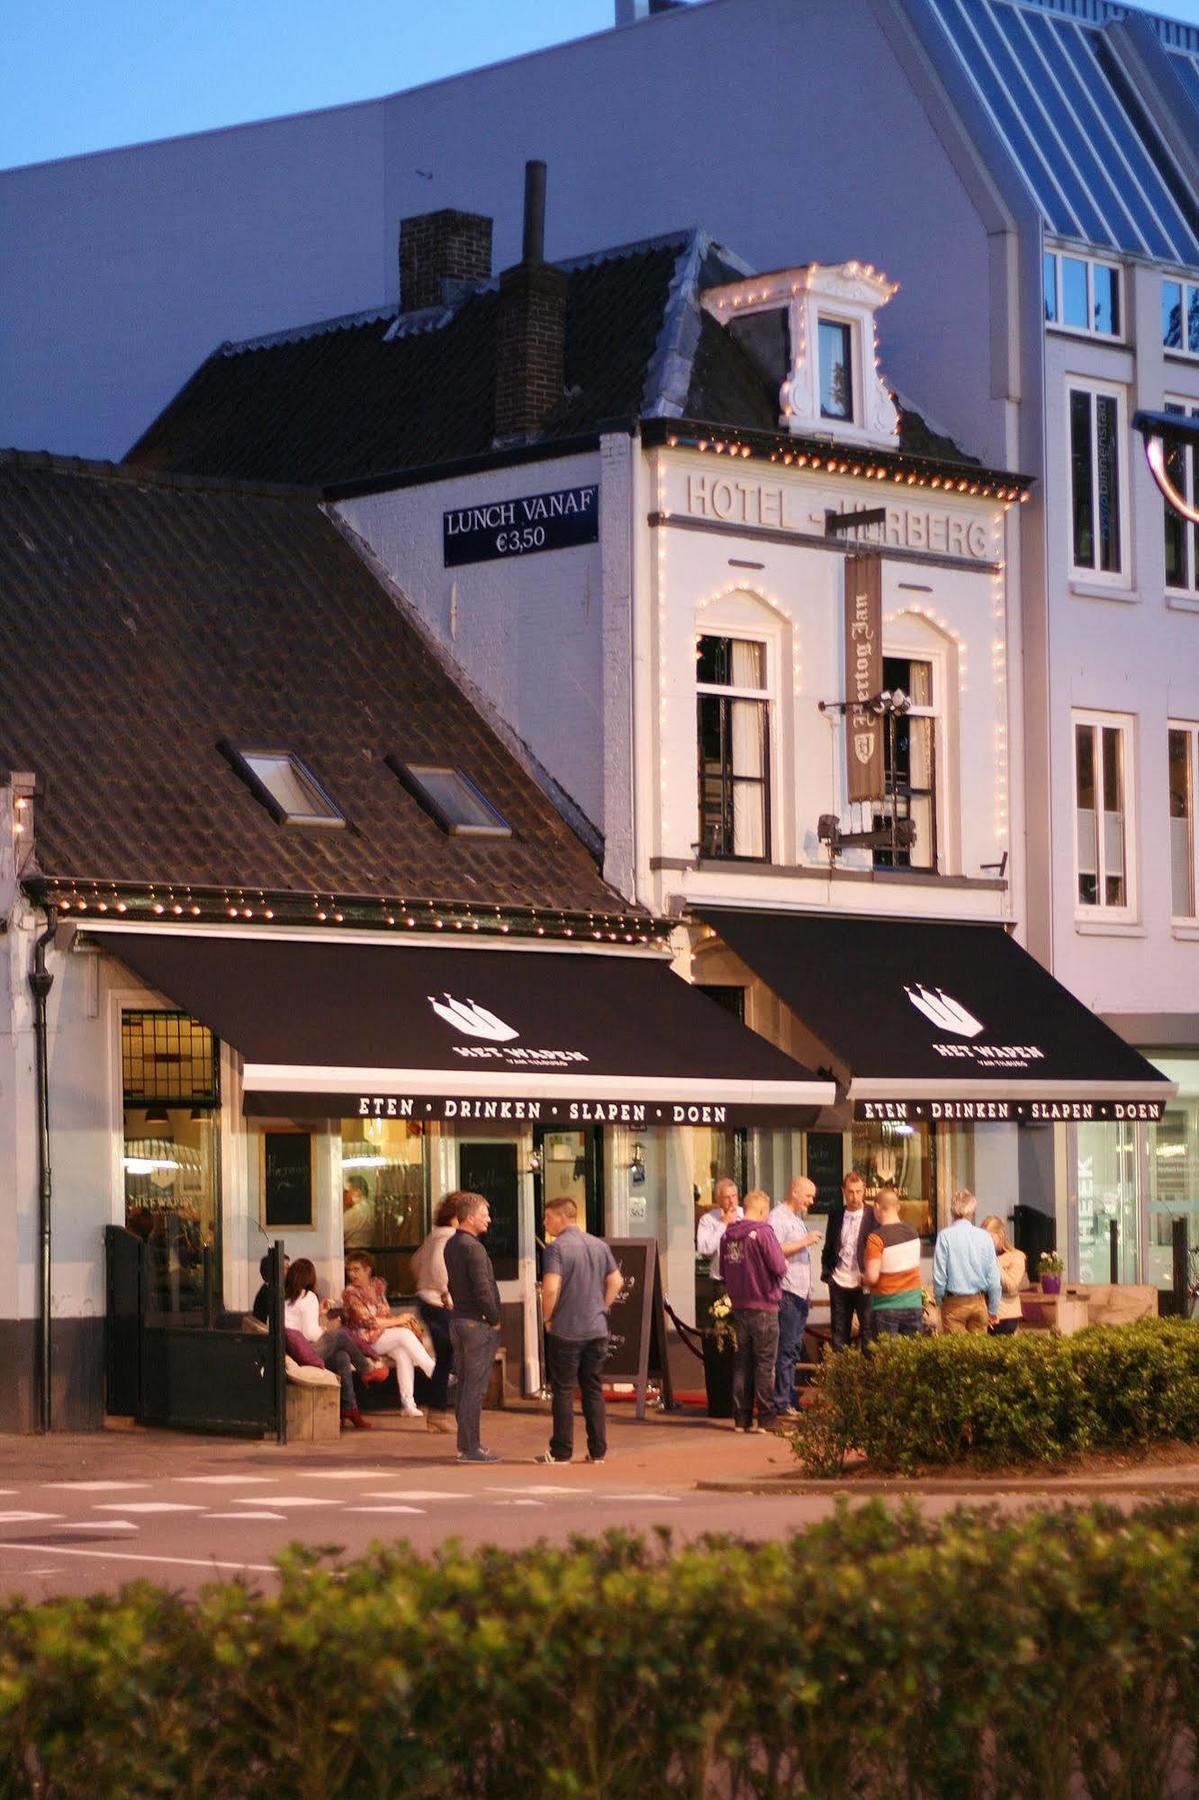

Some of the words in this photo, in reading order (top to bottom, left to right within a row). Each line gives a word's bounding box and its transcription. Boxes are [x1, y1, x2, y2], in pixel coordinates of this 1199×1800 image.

[447, 503, 515, 535] LUNCH
[522, 489, 594, 521] VANAF
[687, 473, 798, 529] HOTEL
[496, 526, 545, 553] €3,50
[851, 593, 873, 640] Jan
[452, 1047, 503, 1057] HET
[503, 1048, 589, 1061] WAPEN
[932, 1044, 974, 1057] HET
[972, 1046, 1045, 1058] WAPEN
[359, 1098, 414, 1115] ETEN
[444, 1100, 541, 1119] DRINKEN
[569, 1103, 645, 1121] SLAPEN
[673, 1106, 726, 1122] DOEN
[864, 1103, 907, 1118] ETEN
[931, 1103, 1009, 1118] DRINKEN
[1031, 1104, 1093, 1118] SLAPEN
[1115, 1104, 1159, 1118] DOEN
